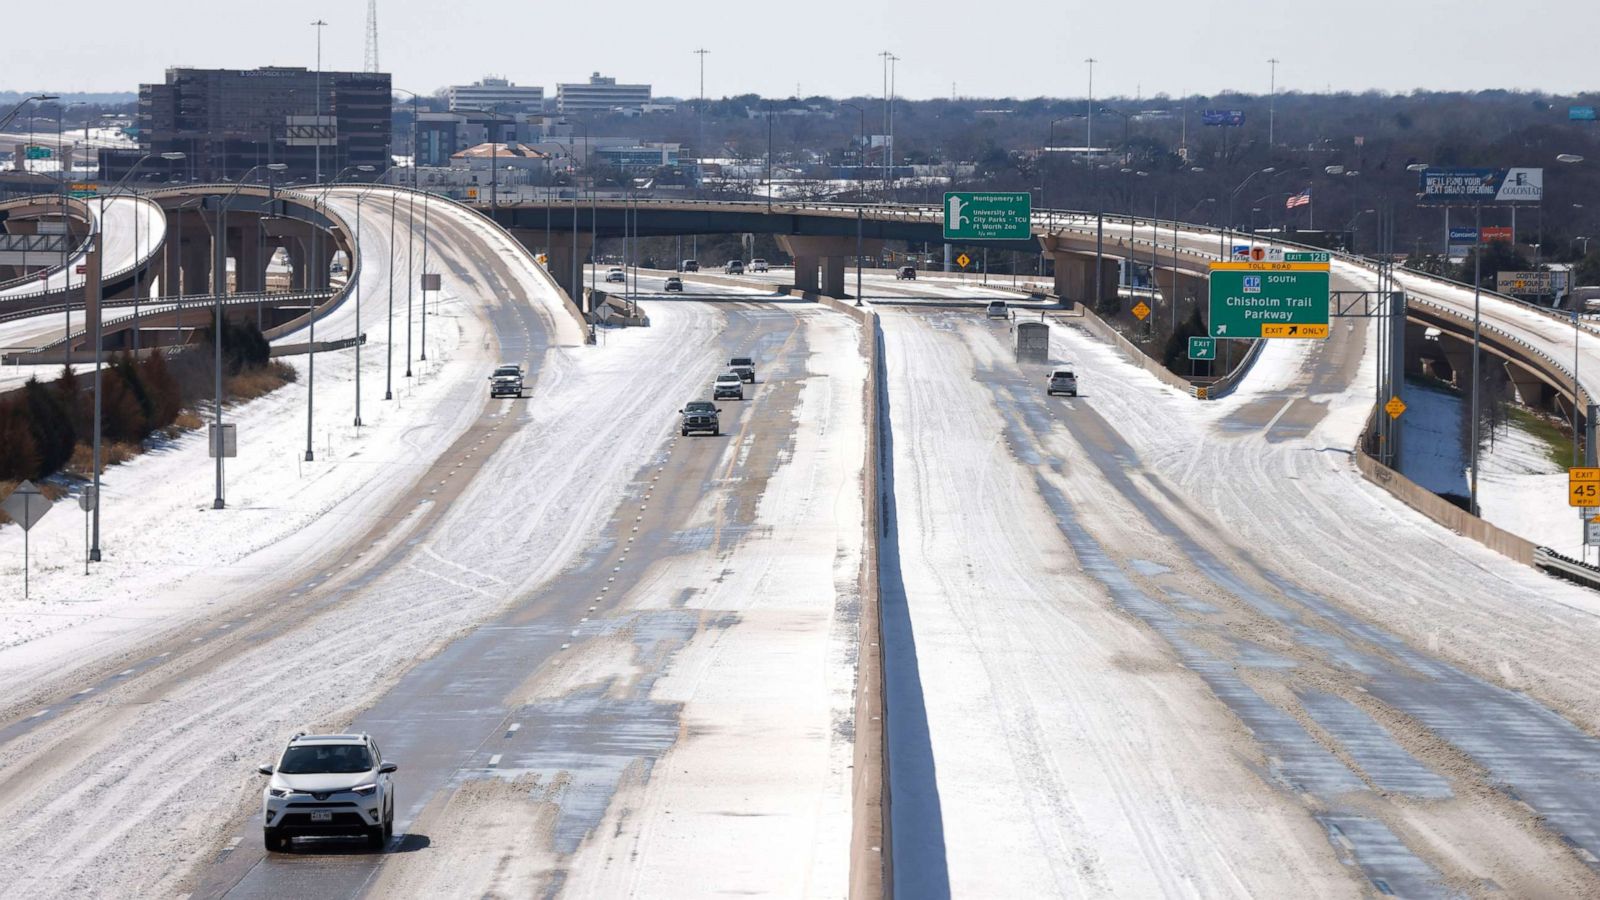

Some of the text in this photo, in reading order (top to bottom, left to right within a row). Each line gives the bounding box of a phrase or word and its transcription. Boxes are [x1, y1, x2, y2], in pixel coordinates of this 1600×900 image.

[1464, 177, 1481, 186] YOUR
[1425, 185, 1444, 194] NEXT
[1502, 186, 1542, 195] COLONIAL
[973, 195, 1014, 203] Montgomery
[973, 209, 1006, 217] University
[1287, 253, 1302, 261] EXIT
[1244, 277, 1260, 287] CTP
[1267, 275, 1297, 283] SOUTH
[1226, 296, 1313, 307] Chisholm Trail
[1244, 309, 1293, 322] Parkway
[1302, 327, 1325, 335] ONLY
[1575, 471, 1594, 479] EXIT
[1574, 484, 1596, 497] 45
